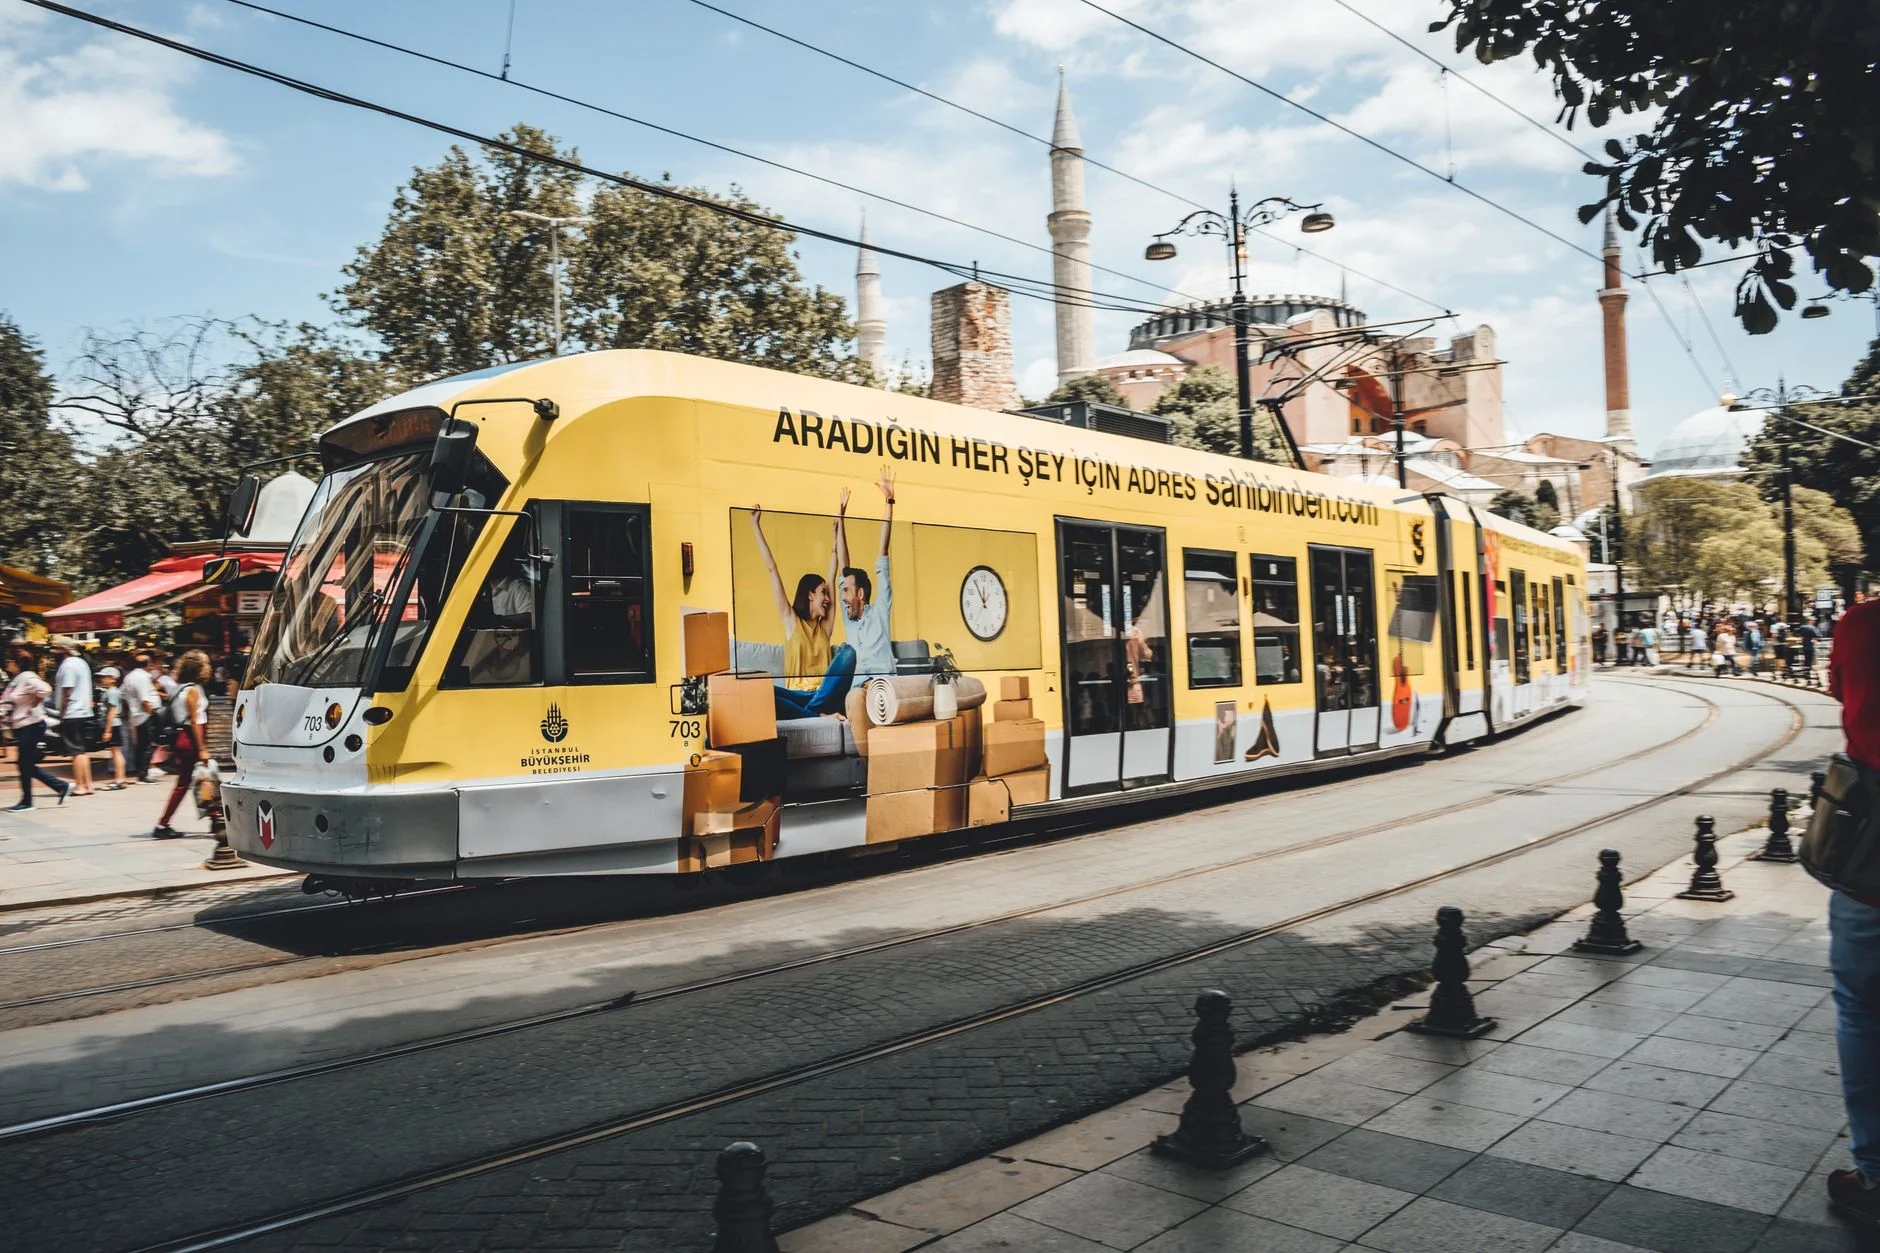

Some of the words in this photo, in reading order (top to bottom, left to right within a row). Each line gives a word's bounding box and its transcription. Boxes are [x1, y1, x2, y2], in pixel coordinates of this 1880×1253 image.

[772, 406, 941, 465] ARADIĞIN
[951, 434, 1009, 474] HER
[1018, 445, 1065, 486] ŞEY
[1070, 448, 1120, 495] İÇİN
[1127, 463, 1196, 500] ADRES
[1205, 468, 1379, 526] sahibinden.com
[304, 716, 323, 731] 703
[669, 720, 701, 738] 703
[531, 746, 579, 755] İSTANBUL
[532, 765, 581, 775] BELEDİYESİ
